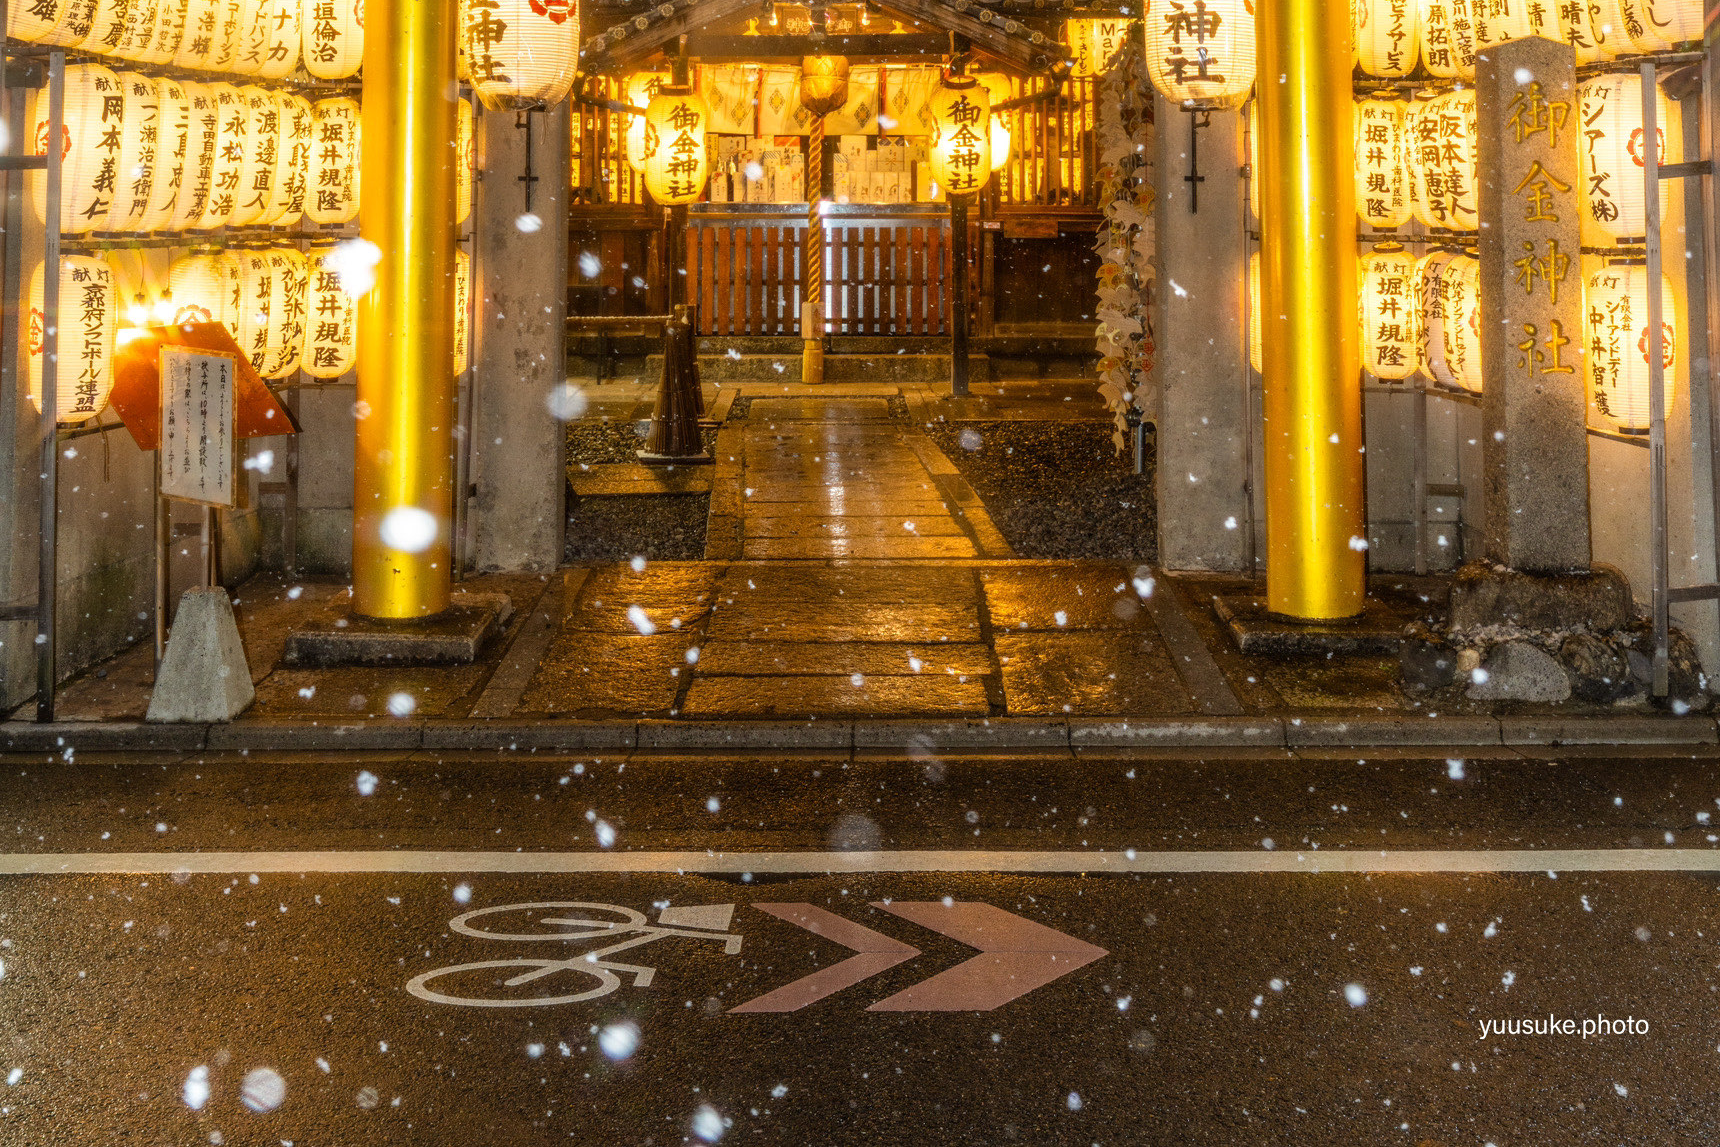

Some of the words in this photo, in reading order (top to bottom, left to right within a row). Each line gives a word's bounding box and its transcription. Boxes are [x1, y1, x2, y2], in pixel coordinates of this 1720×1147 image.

[79, 95, 124, 221] 岡本義仁
[318, 106, 349, 120] 献灯
[664, 102, 701, 199] 御金神社
[945, 94, 982, 191] 御金神社
[1364, 108, 1395, 122] 献灯
[184, 113, 217, 222] 寺田自動車工業所
[316, 122, 344, 212] 堀井規隆
[1364, 123, 1392, 219] 堀井規隆
[1418, 115, 1449, 222] 安岡恵子
[1440, 113, 1477, 218] 阪本達人
[71, 267, 110, 284] 献灯
[1373, 261, 1408, 276] 献灯
[1505, 80, 1573, 378] 御金神社
[68, 282, 109, 414] 京都府ソフトボール連盟
[313, 271, 344, 369] 堀井規隆
[1375, 276, 1408, 368] 堀井規隆
[1605, 300, 1621, 389] シーアンドディー
[1619, 294, 1633, 332] 有限会社
